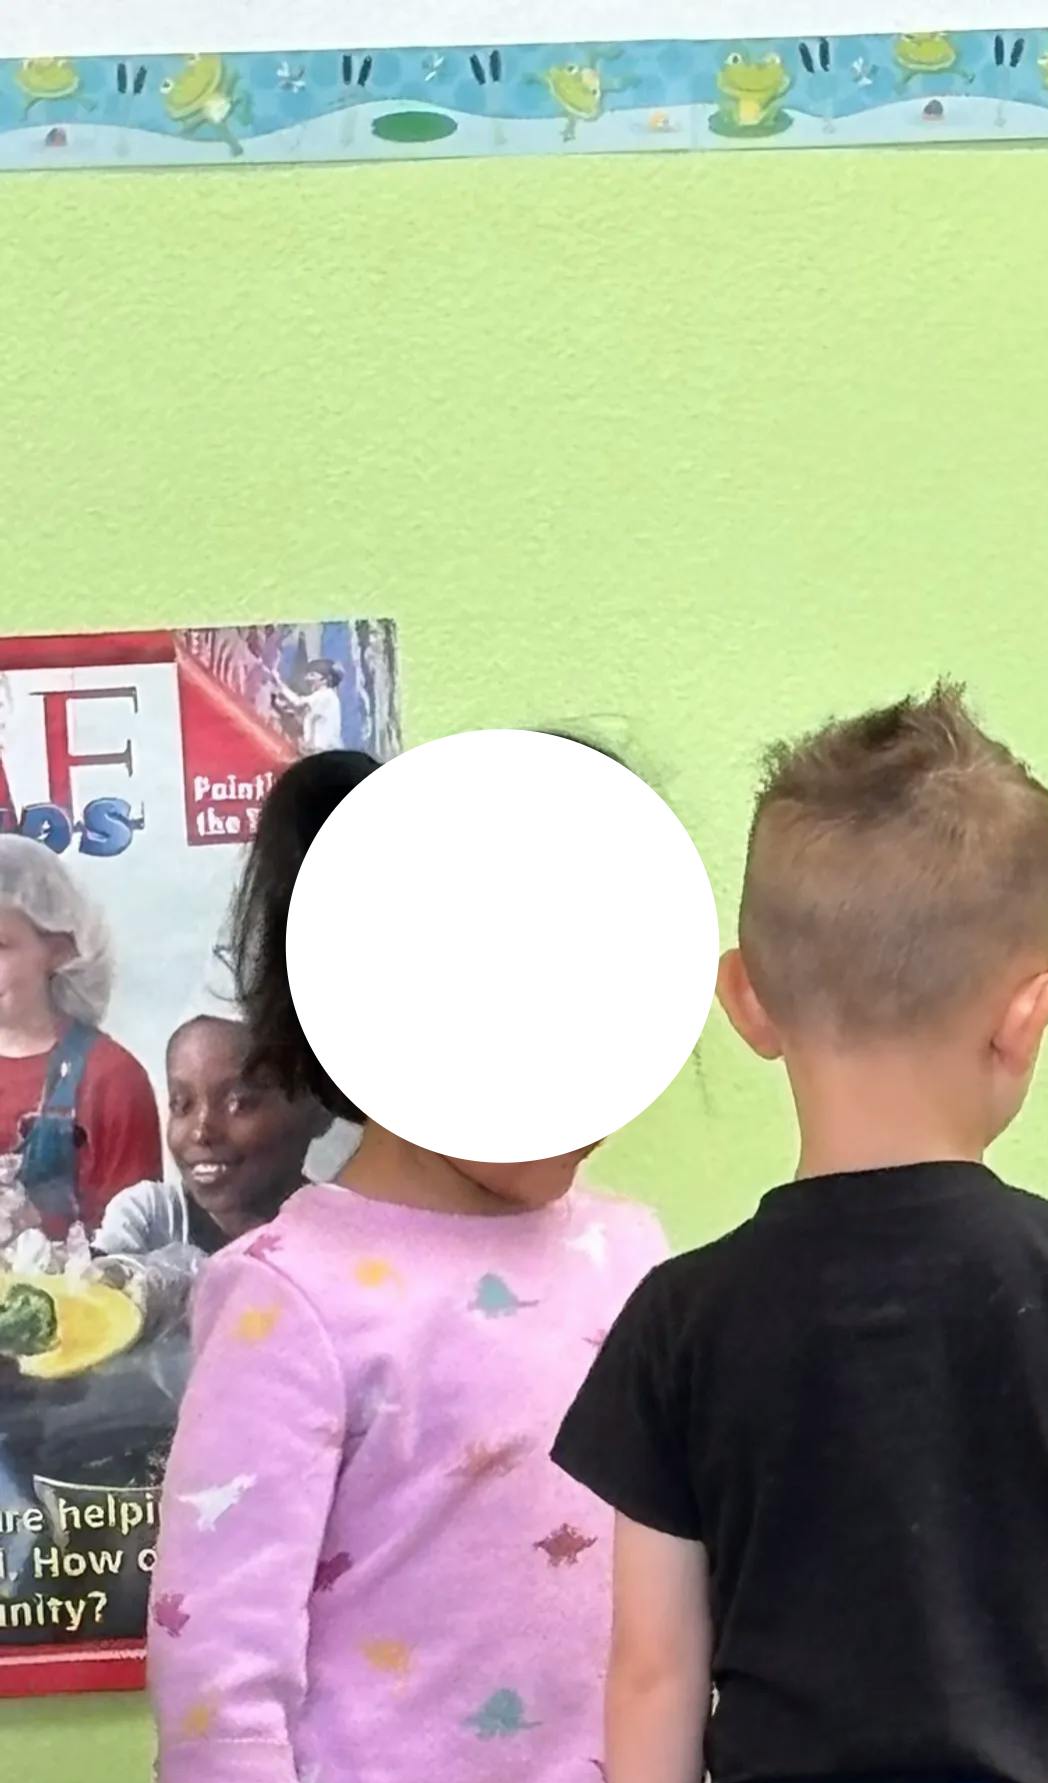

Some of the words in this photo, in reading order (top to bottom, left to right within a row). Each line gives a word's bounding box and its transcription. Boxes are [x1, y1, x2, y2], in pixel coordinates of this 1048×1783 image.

[194, 771, 274, 802] Painti
[196, 806, 241, 836] the
[34, 1546, 124, 1578] How
